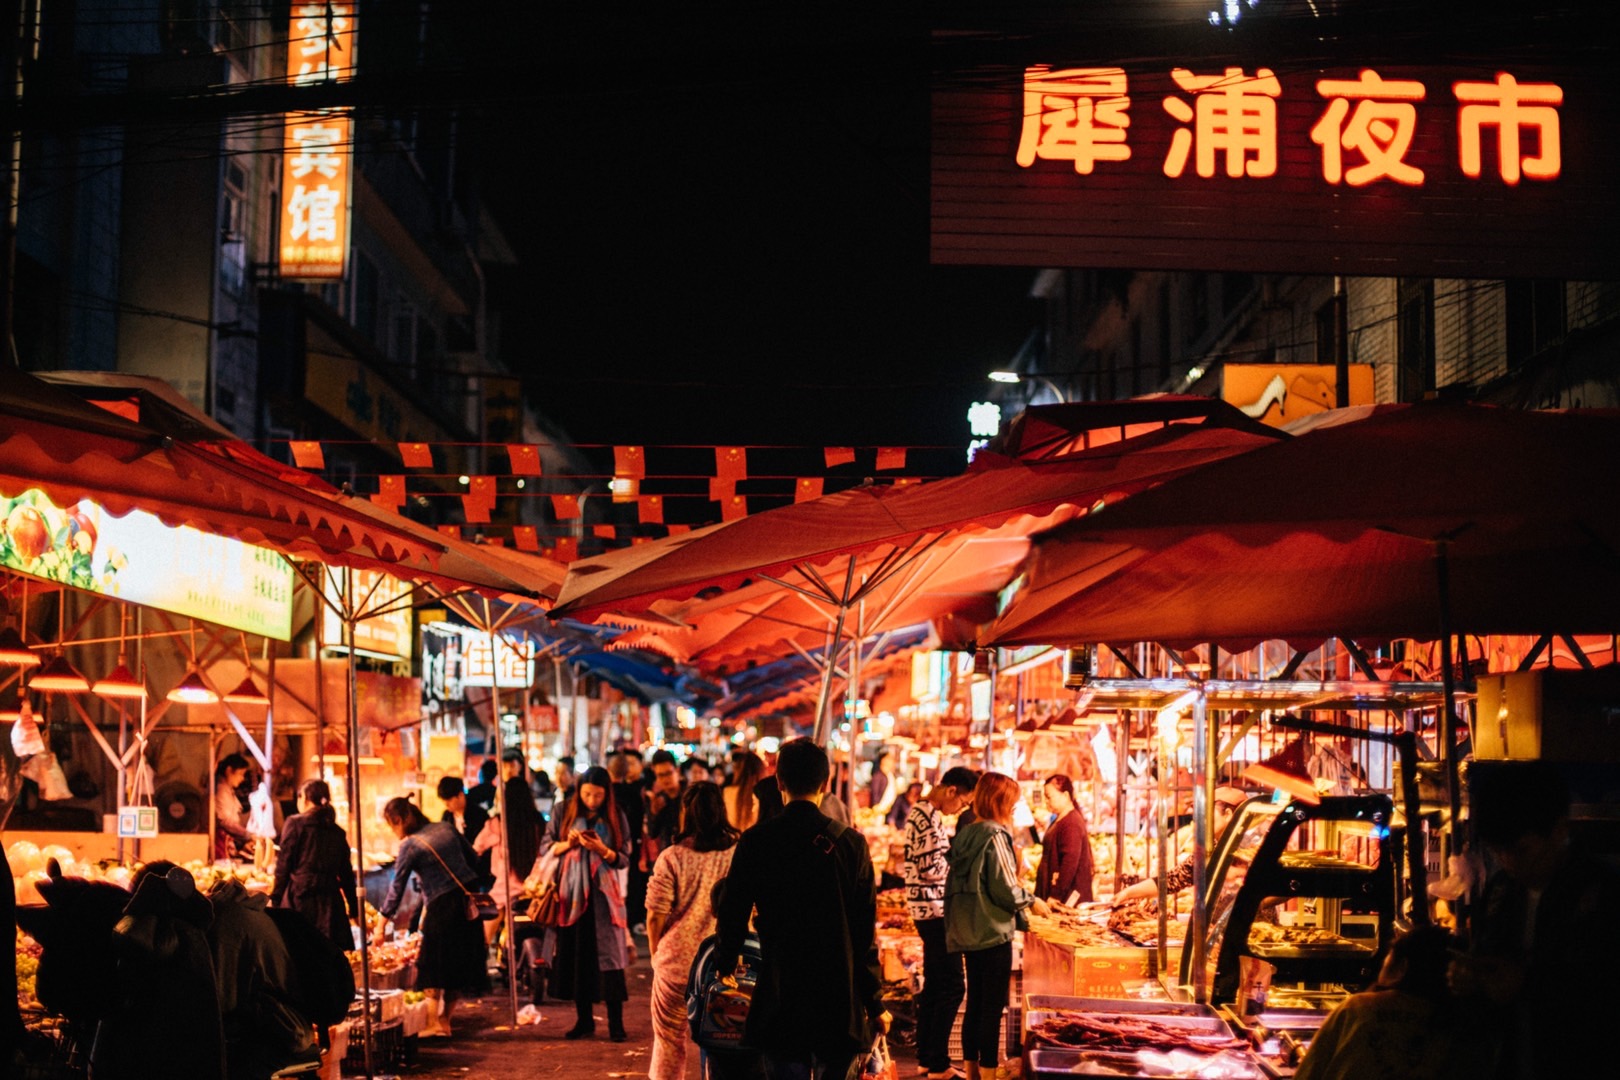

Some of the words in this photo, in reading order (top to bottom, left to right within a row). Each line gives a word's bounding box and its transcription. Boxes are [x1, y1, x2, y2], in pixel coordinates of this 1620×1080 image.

[1016, 66, 1563, 185] 犀浦夜市
[462, 639, 527, 680] 住宿
